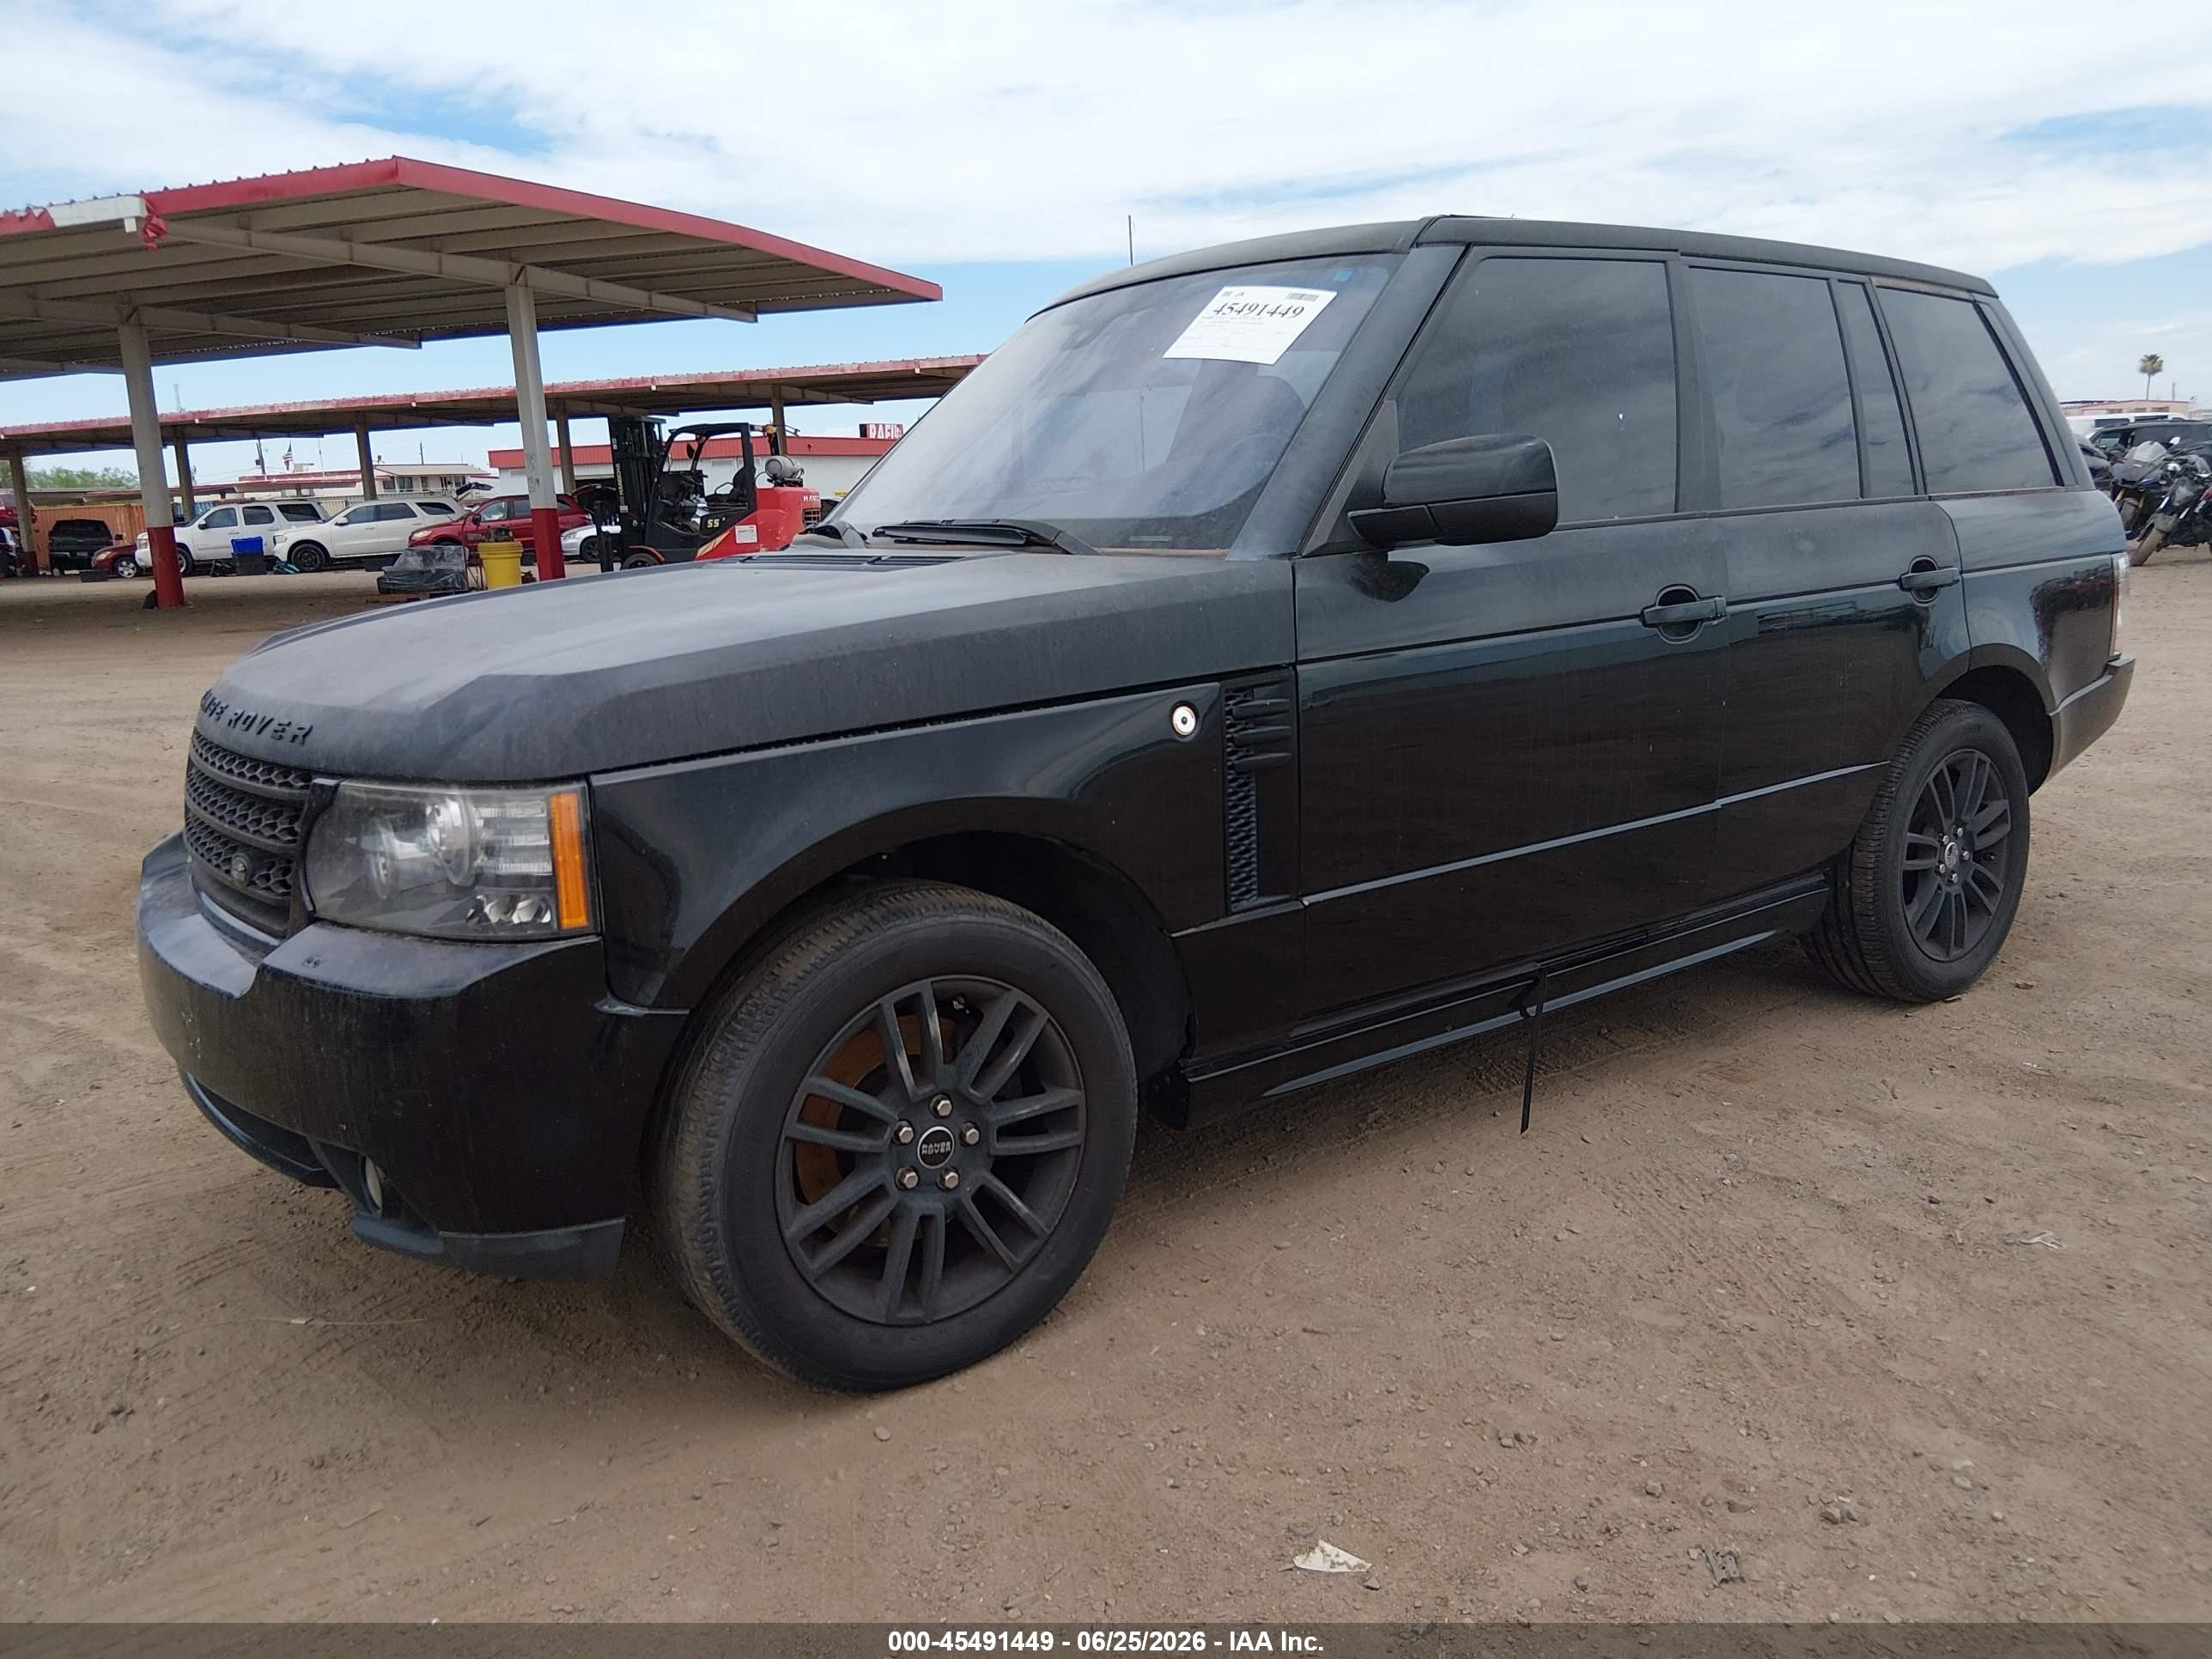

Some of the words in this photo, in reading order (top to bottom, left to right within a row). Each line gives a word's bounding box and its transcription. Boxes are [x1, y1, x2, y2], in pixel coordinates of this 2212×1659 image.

[1213, 302, 1304, 319] 45491449
[228, 710, 313, 745] ROVER
[921, 1141, 951, 1155] ROVER
